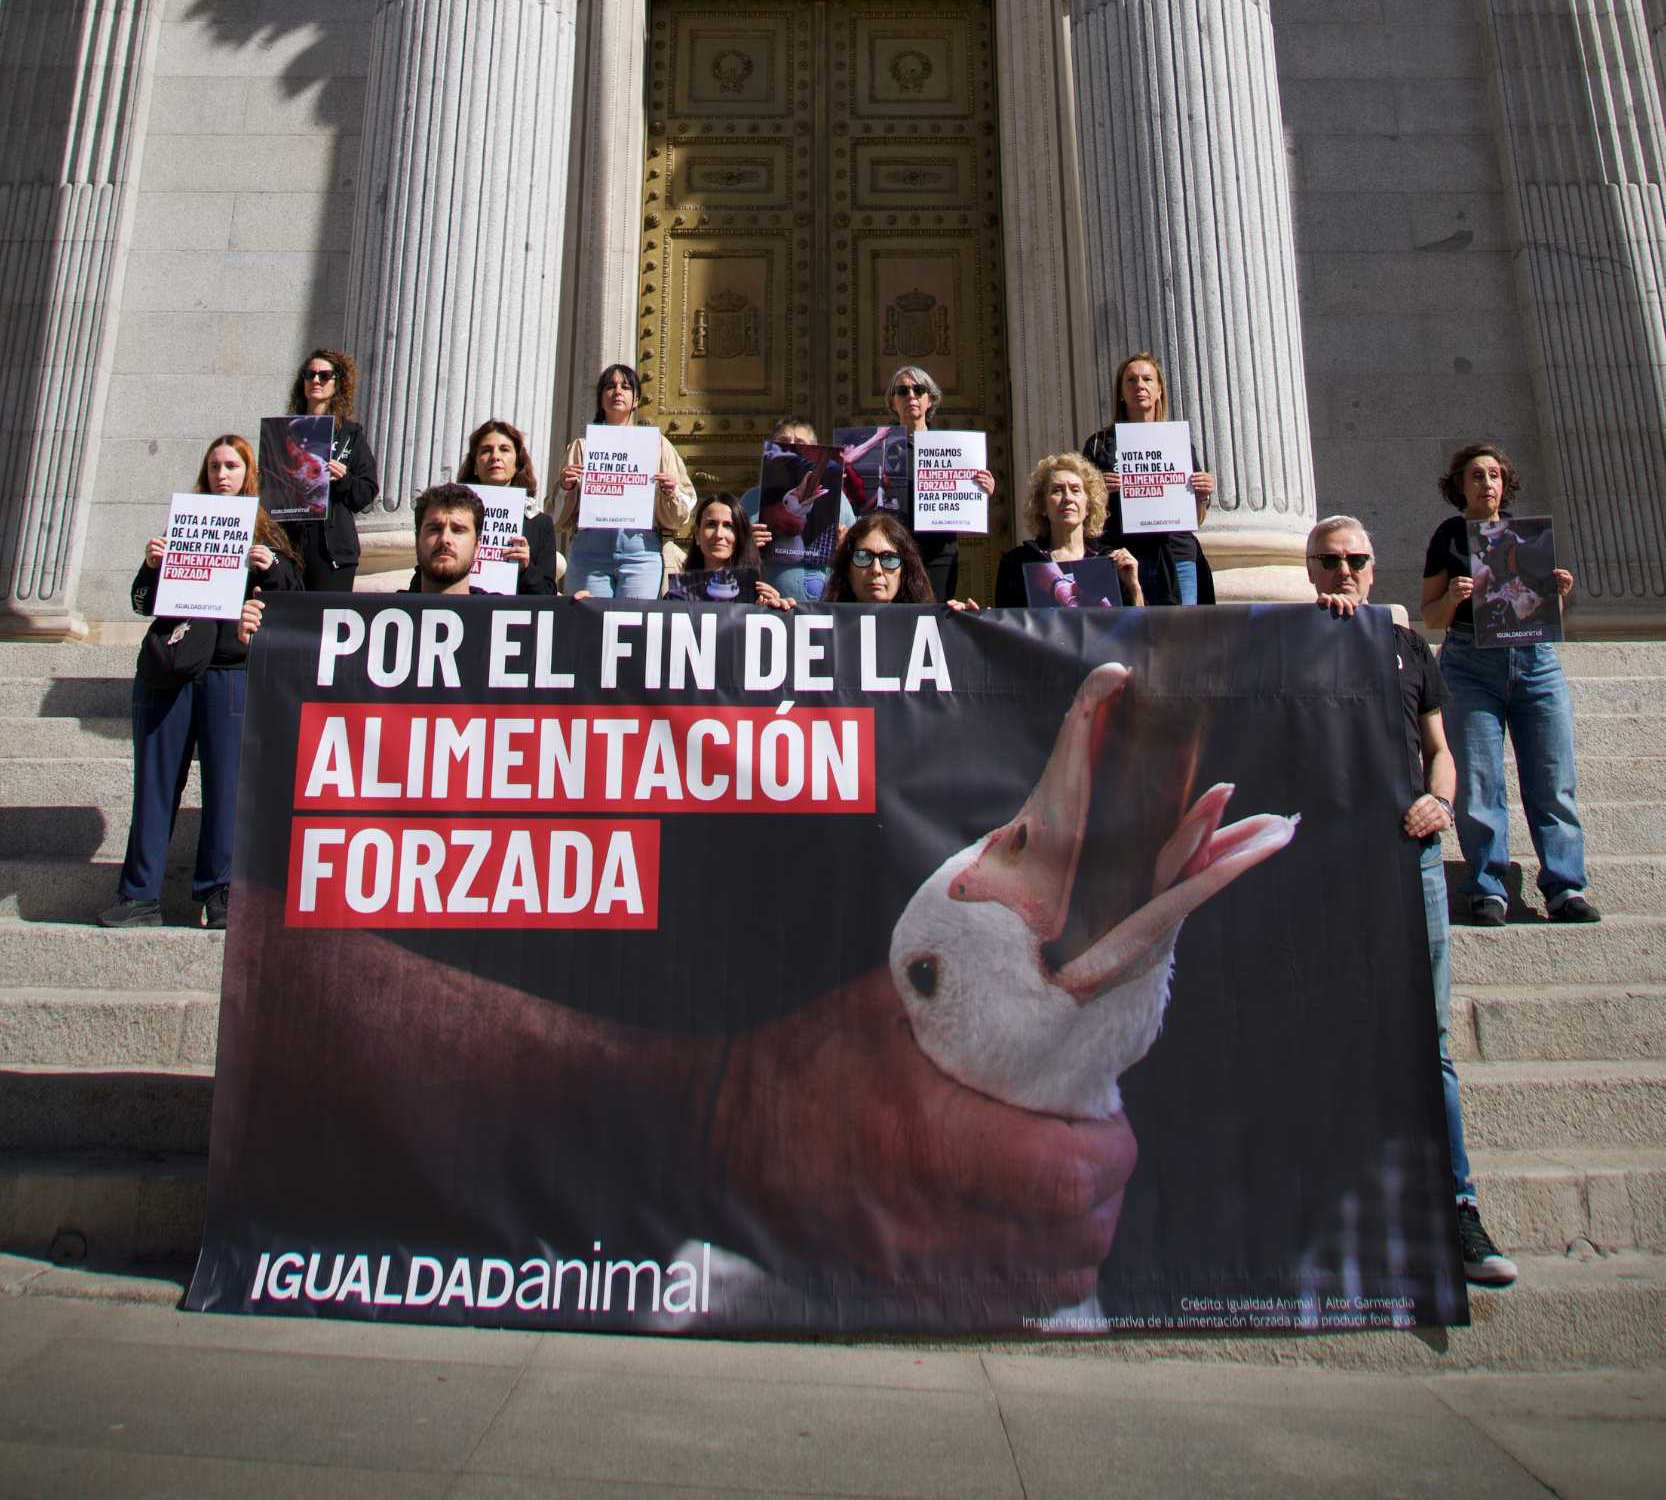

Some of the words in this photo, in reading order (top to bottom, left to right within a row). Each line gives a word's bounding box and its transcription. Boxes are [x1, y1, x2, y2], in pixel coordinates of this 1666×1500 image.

[589, 452, 609, 460] VOTA
[612, 453, 628, 461] POR
[919, 449, 962, 457] PONGAMOS
[1122, 452, 1144, 461] VOTA
[1146, 451, 1162, 460] POR
[588, 463, 597, 471] EL
[600, 464, 613, 472] FIN
[616, 464, 625, 472] DE
[628, 464, 639, 473] LA
[919, 460, 931, 468] FIN
[934, 460, 940, 468] A
[942, 460, 952, 468] LA
[1123, 464, 1132, 473] EL
[1135, 463, 1149, 473] FIN
[1151, 463, 1161, 472] DE
[1164, 463, 1175, 472] LA
[585, 485, 623, 495] FORZADA
[919, 481, 955, 490] FORZADA
[942, 492, 982, 500] PRODUCIR
[1125, 486, 1162, 497] FORZADA
[919, 503, 936, 511] FOIE
[939, 503, 960, 511] GRAS
[484, 508, 509, 519] AVOR
[174, 514, 198, 525] VOTA
[201, 515, 207, 526] A
[210, 516, 241, 527] FAVOR
[493, 522, 518, 533] PARA
[172, 528, 183, 538] DE
[187, 528, 199, 539] LA
[202, 529, 220, 540] PNL
[223, 530, 248, 541] PARA
[493, 536, 499, 546] A
[169, 541, 202, 552] PONER
[204, 542, 220, 553] FIN
[222, 544, 229, 554] A
[232, 544, 244, 555] LA
[165, 568, 209, 580] FORZADA
[317, 608, 463, 689] POR
[488, 610, 575, 689] EL
[600, 611, 715, 690] FIN
[743, 613, 833, 691] DE
[860, 615, 952, 692] LA
[304, 700, 859, 801] ALIMENTACIÓN
[298, 828, 644, 914] FORZADA
[250, 1241, 710, 1313] IGUALDADanimal
[1181, 1297, 1224, 1311] Crédito:
[1227, 1297, 1273, 1313] Igualdad
[1277, 1297, 1313, 1310] Animal
[1326, 1297, 1351, 1310] Aitor
[1355, 1296, 1415, 1309] Garmendia
[1022, 1316, 1063, 1331] Imagen
[1066, 1316, 1145, 1331] representativa
[1148, 1314, 1161, 1328] de
[1165, 1314, 1174, 1328] la
[1177, 1313, 1246, 1328] alimentación
[1250, 1313, 1291, 1327] forzada
[1294, 1316, 1318, 1329] para
[1322, 1313, 1367, 1329] producir
[1370, 1312, 1392, 1325] foie
